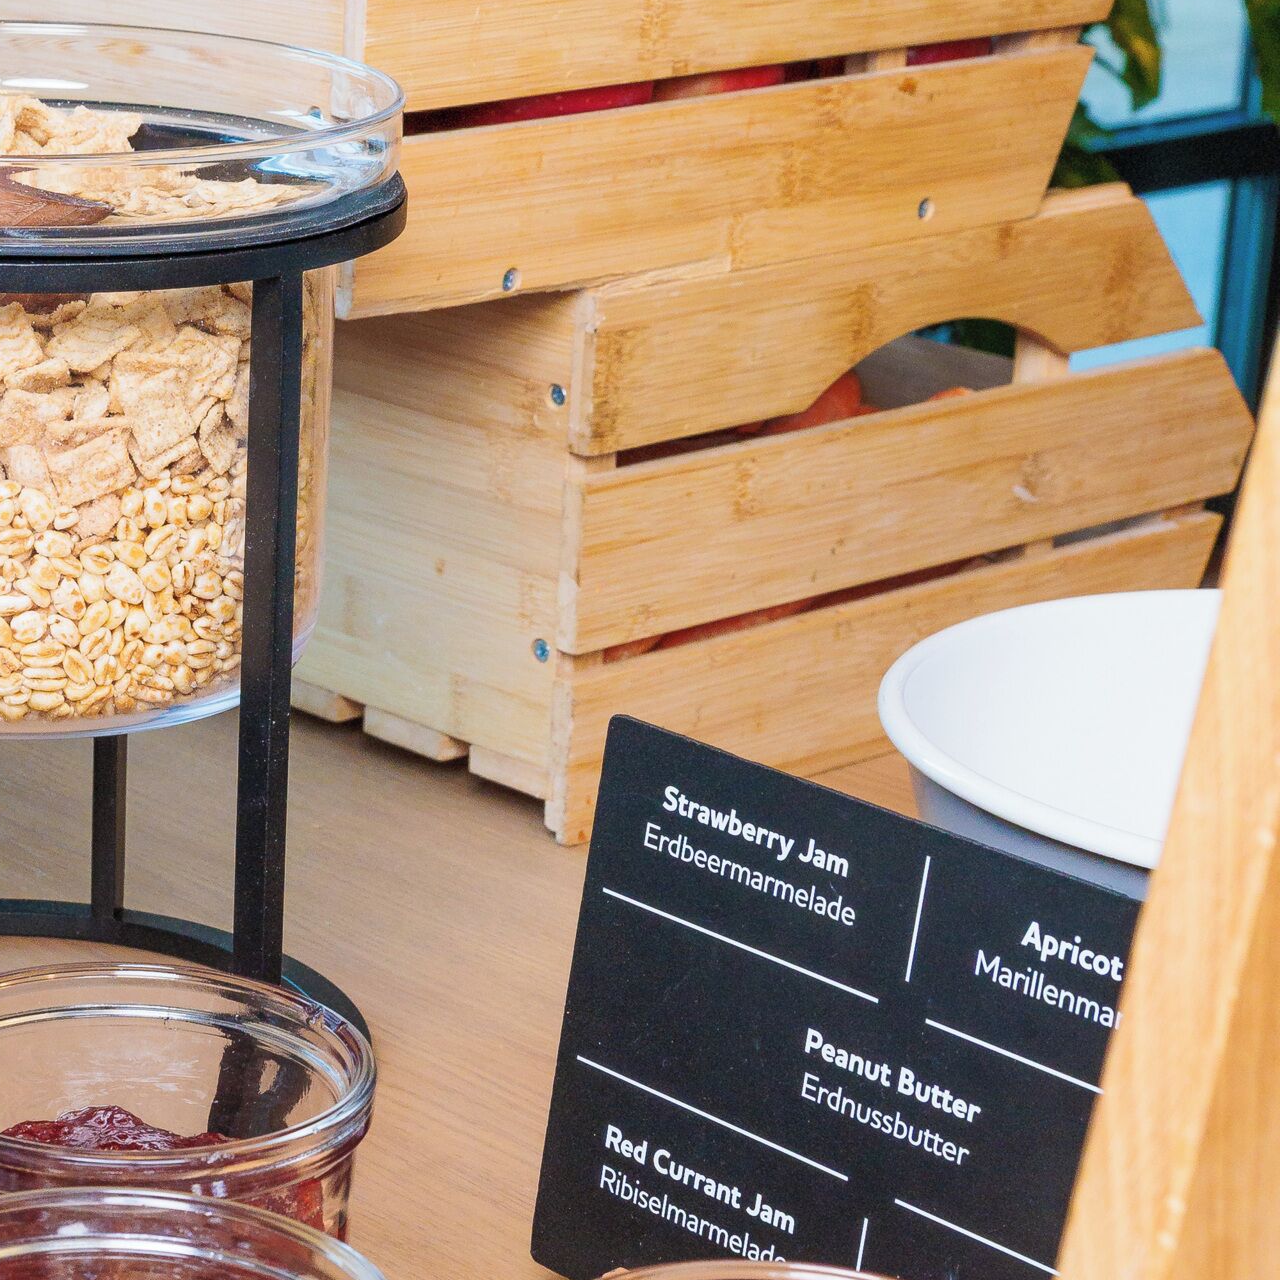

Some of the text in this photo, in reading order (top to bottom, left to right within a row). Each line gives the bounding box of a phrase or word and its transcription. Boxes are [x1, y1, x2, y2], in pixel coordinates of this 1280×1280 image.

[643, 821, 856, 926] Erdbeermarmelade
[663, 785, 849, 878] Strawberry Jam
[1021, 921, 1124, 982] Apricot
[801, 1071, 970, 1166] Erdnussbutter
[804, 1027, 981, 1123] Peanut Butter
[605, 1123, 795, 1235] Red Currant Jam
